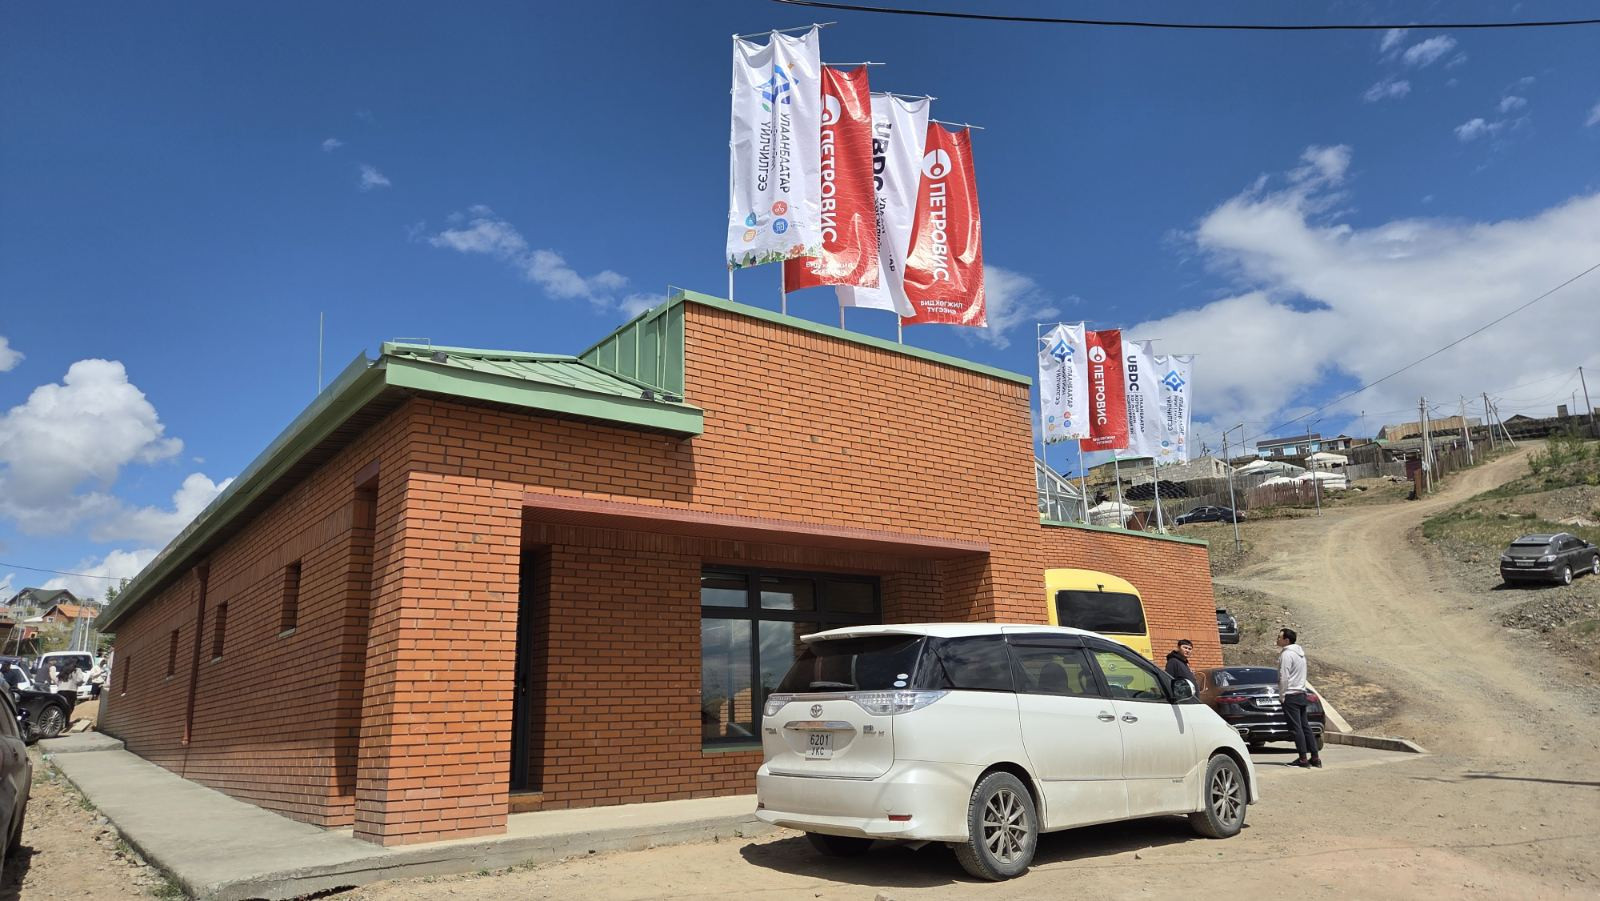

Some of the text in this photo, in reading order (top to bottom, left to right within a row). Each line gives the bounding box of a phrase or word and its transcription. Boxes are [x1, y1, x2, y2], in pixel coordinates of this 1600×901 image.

[758, 121, 772, 192] ҮЙЛЧИЛГЭЭ
[779, 112, 791, 193] УЛААНБААТАР
[820, 130, 837, 243] ПЕТРОВИС
[930, 181, 949, 282] ПЕТРОВИС
[1094, 365, 1107, 425] ПЕТРОВИС
[1127, 355, 1139, 391] UBDC
[810, 734, 828, 746] 6201
